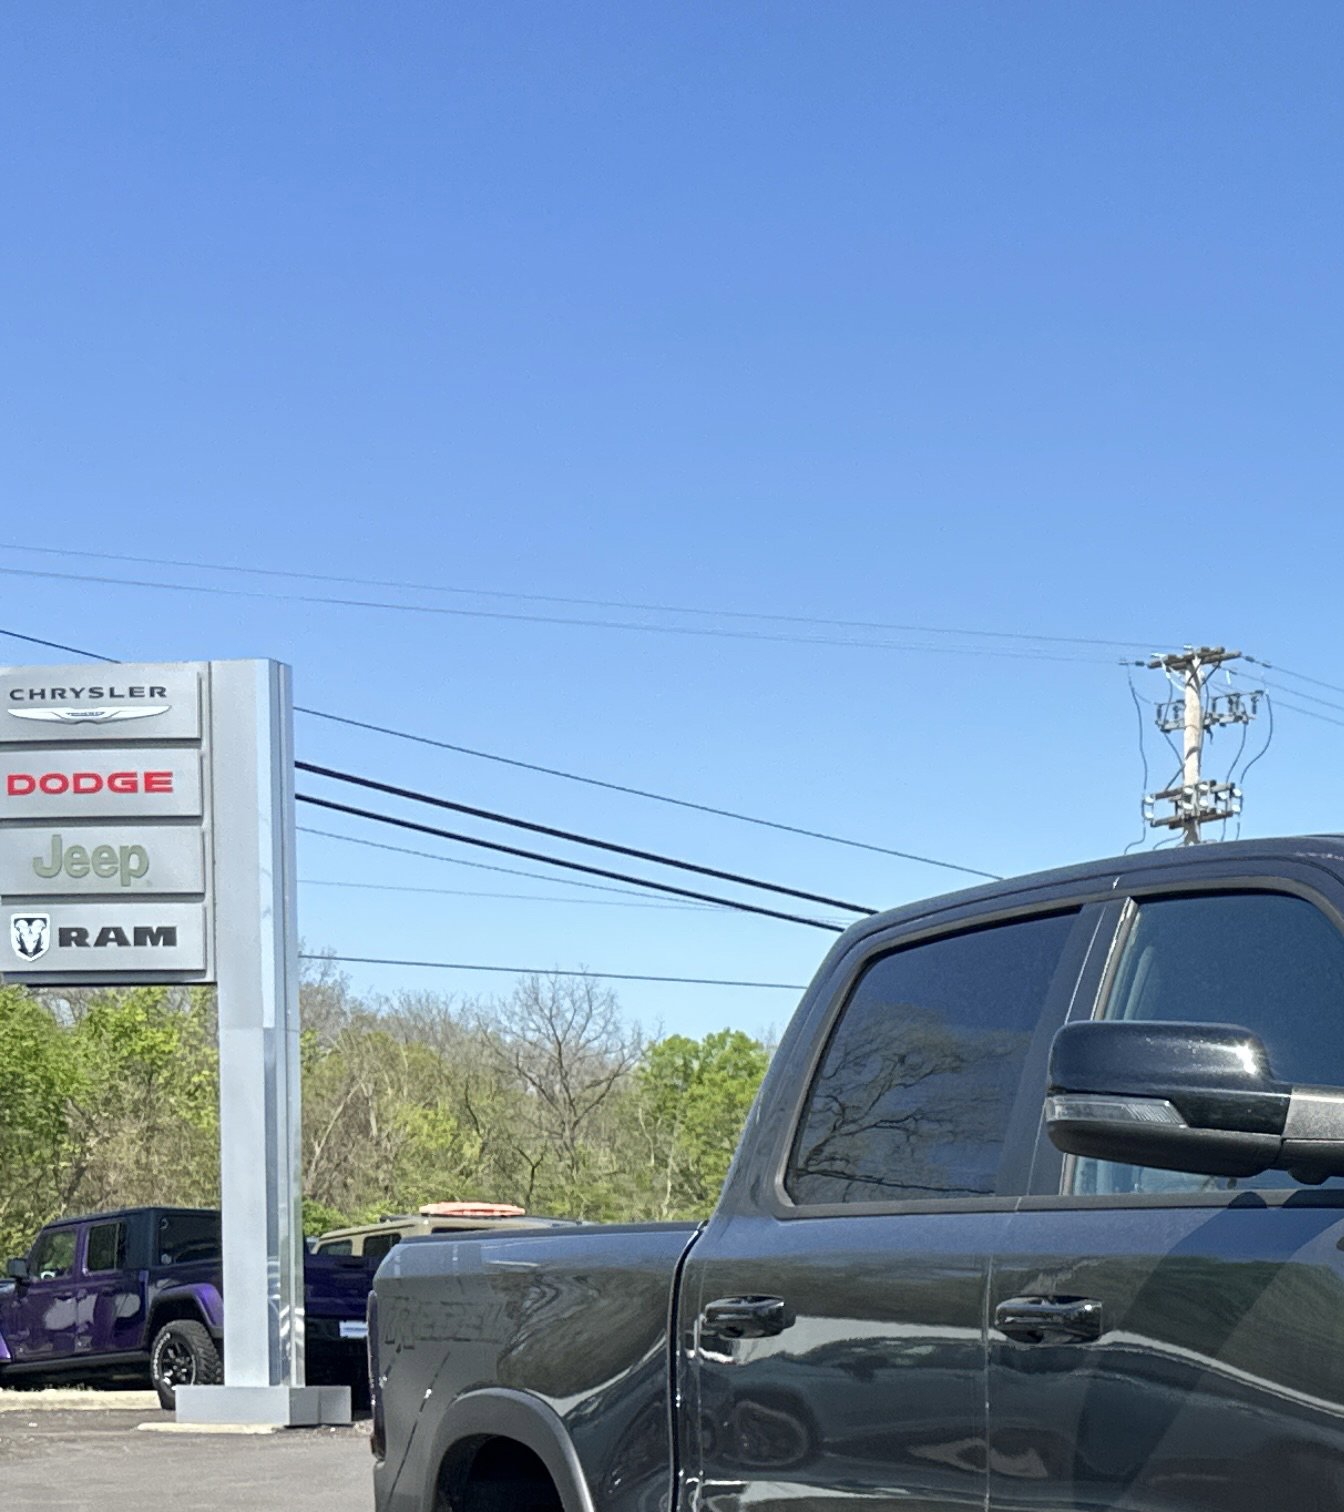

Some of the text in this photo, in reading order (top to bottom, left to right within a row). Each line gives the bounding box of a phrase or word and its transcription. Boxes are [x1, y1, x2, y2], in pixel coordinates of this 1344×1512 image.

[9, 686, 168, 700] CHRYSLER
[7, 771, 173, 796] DODGE
[32, 834, 150, 887] Jeep
[58, 926, 178, 947] RAM
